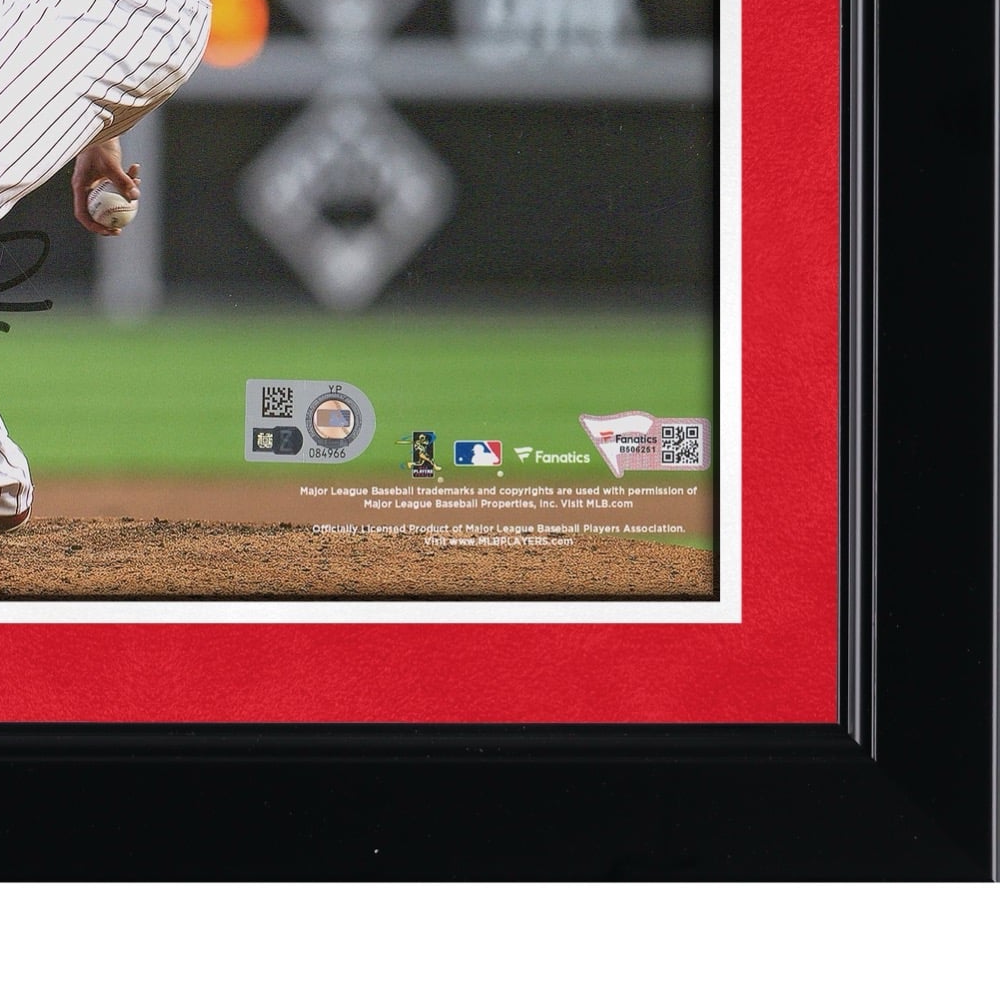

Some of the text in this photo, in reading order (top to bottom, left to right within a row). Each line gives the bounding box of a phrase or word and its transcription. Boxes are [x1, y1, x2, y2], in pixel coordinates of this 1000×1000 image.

[328, 385, 343, 394] YP
[615, 434, 658, 444] Fanatics
[308, 447, 347, 459] 084966
[535, 450, 591, 464] Fanatics
[300, 486, 698, 498] Major League Baseball trademarks and copyrights are used with permission of
[363, 499, 633, 510] Major League Baseball Properties, Inc. Visit MLB.com
[312, 524, 686, 535] Officially Licensed Product of Major League Baseball Players Association.
[424, 536, 447, 546] Visit
